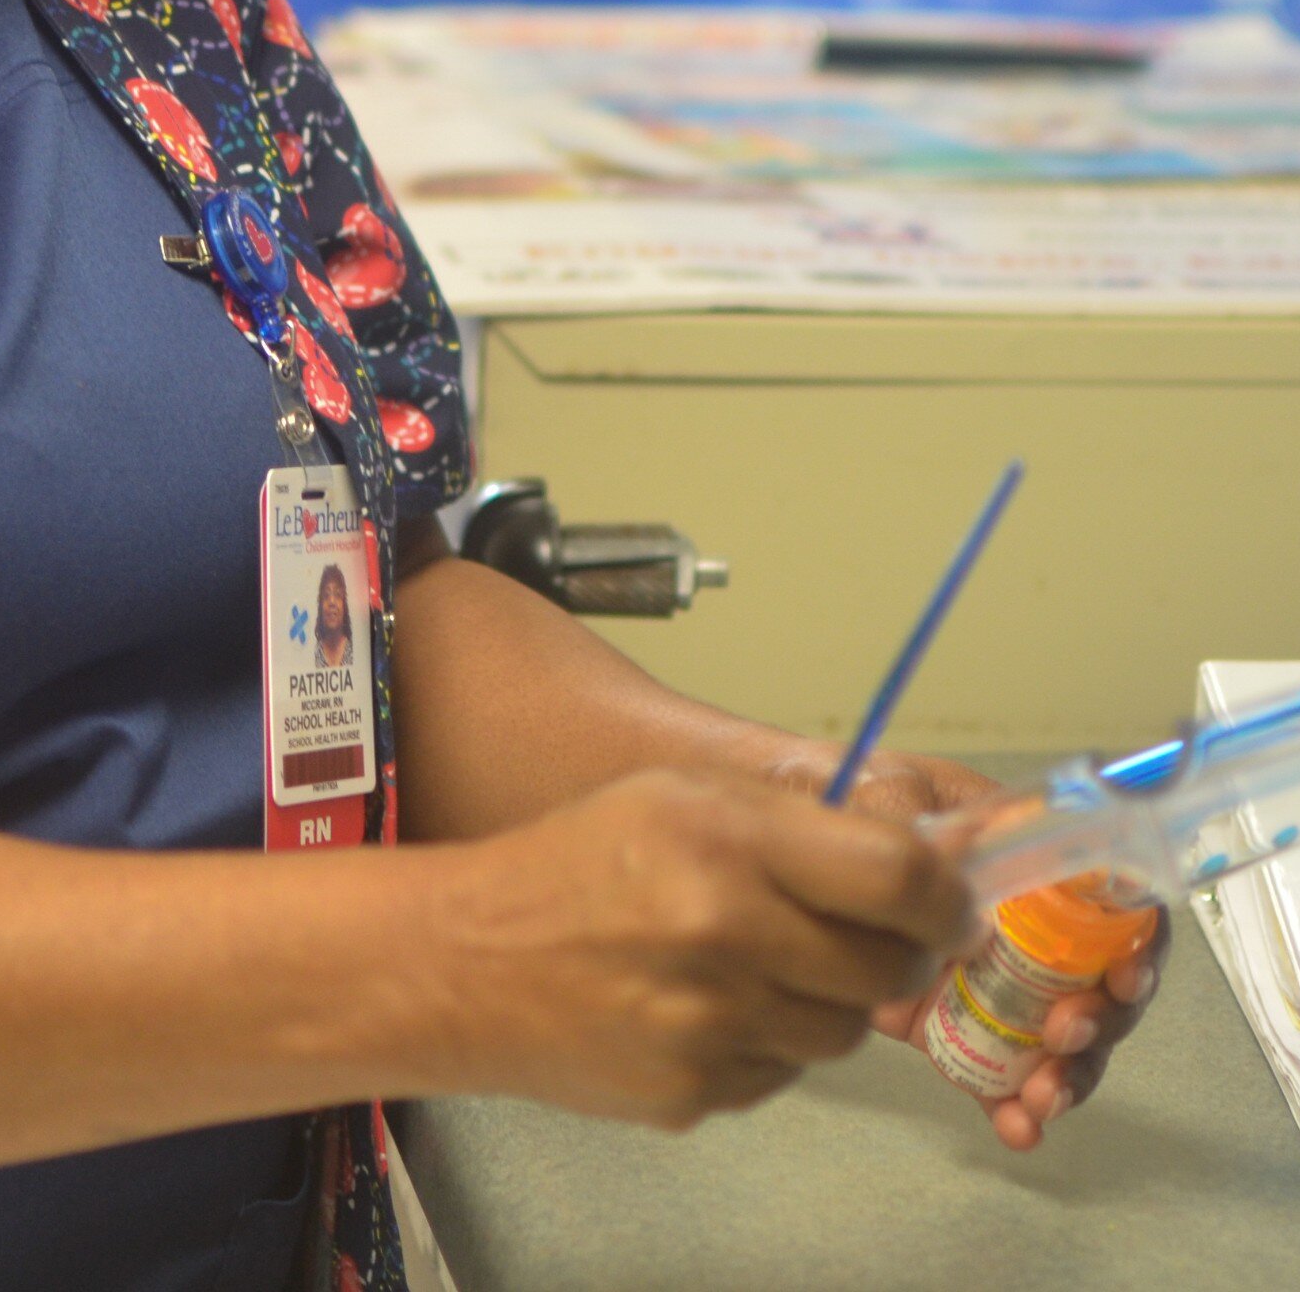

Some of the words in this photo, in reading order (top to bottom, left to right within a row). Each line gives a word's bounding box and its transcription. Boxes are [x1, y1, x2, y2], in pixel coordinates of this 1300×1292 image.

[274, 506, 291, 537] Le
[289, 669, 353, 698] PATRICIA
[284, 713, 322, 733] SCHOOL
[325, 708, 361, 727] HEALTH
[288, 735, 313, 749] SCHOOL
[314, 732, 338, 744] HEALTH
[340, 729, 360, 742] NURSE
[300, 815, 332, 846] RN
